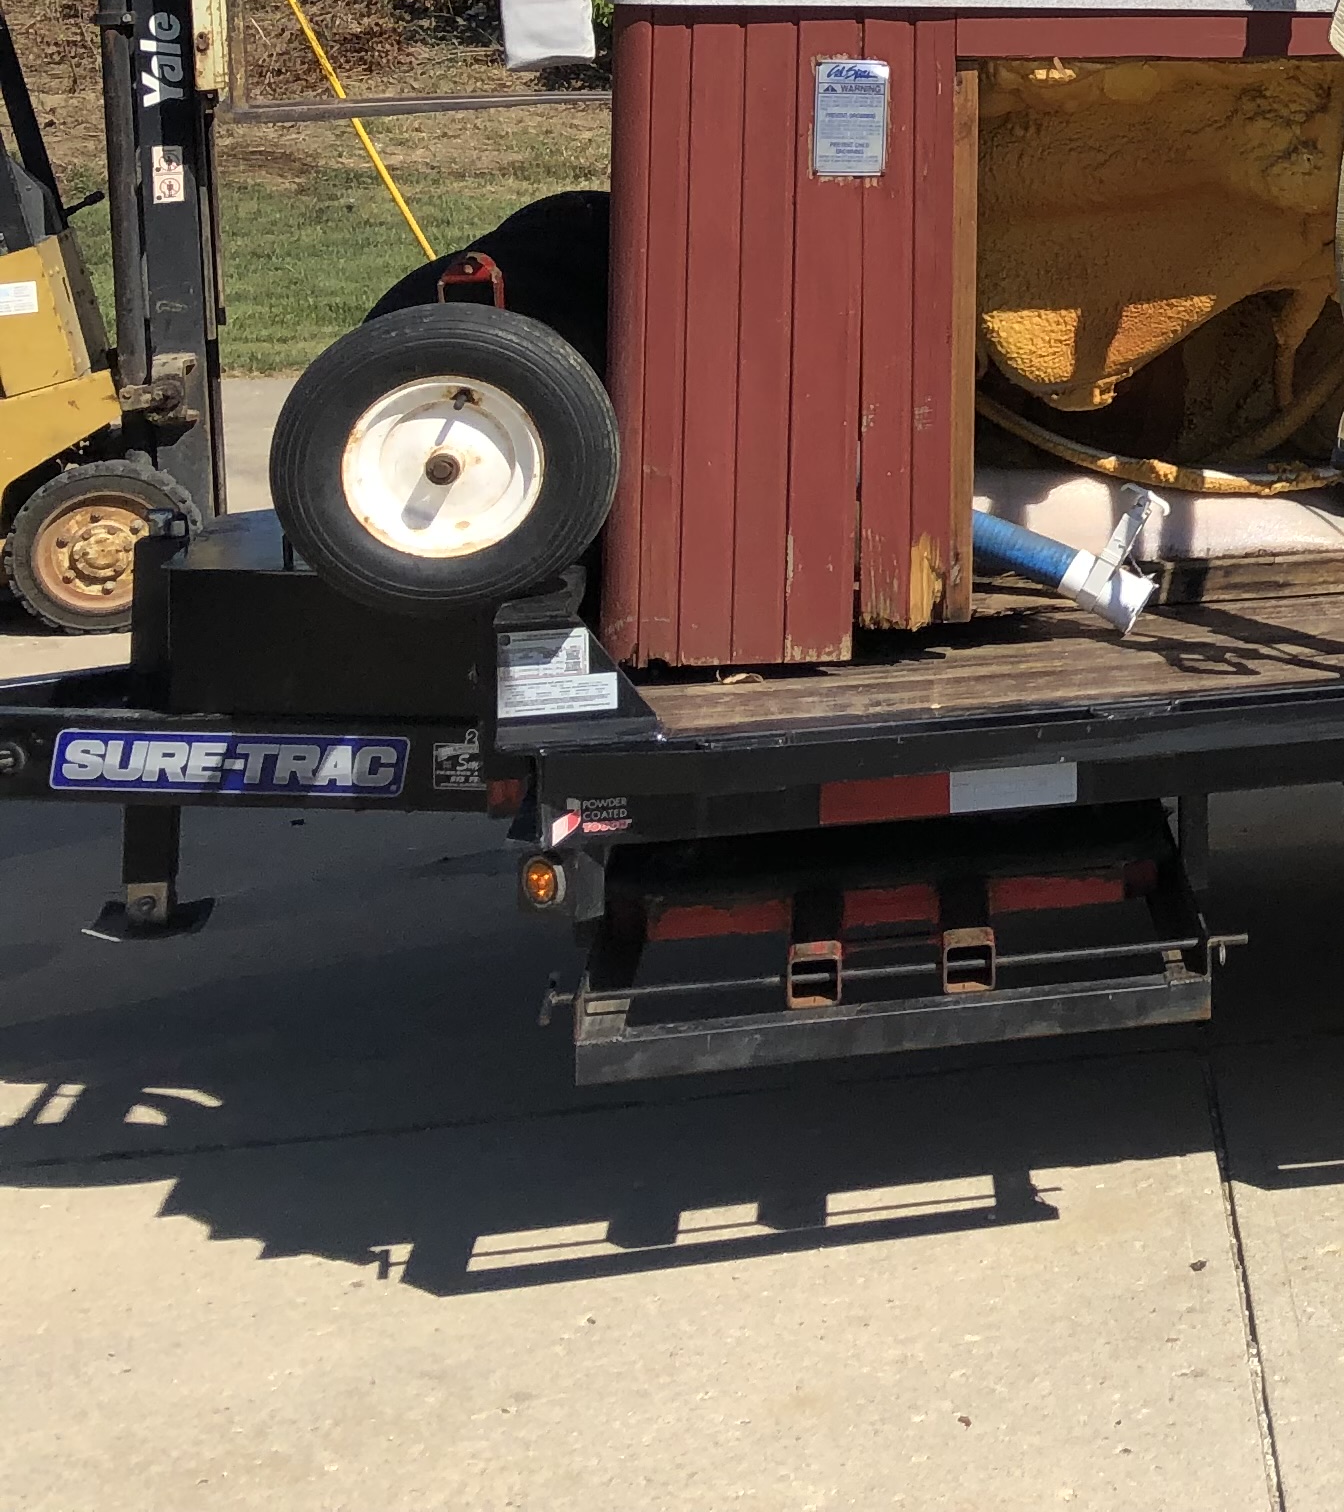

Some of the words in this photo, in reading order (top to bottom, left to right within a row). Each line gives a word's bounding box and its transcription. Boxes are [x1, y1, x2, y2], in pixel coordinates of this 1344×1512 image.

[139, 11, 184, 108] Yale
[841, 84, 882, 94] WARNING
[61, 738, 398, 788] SURE-TRAC
[582, 797, 628, 809] POWDER
[582, 808, 628, 820] COATED
